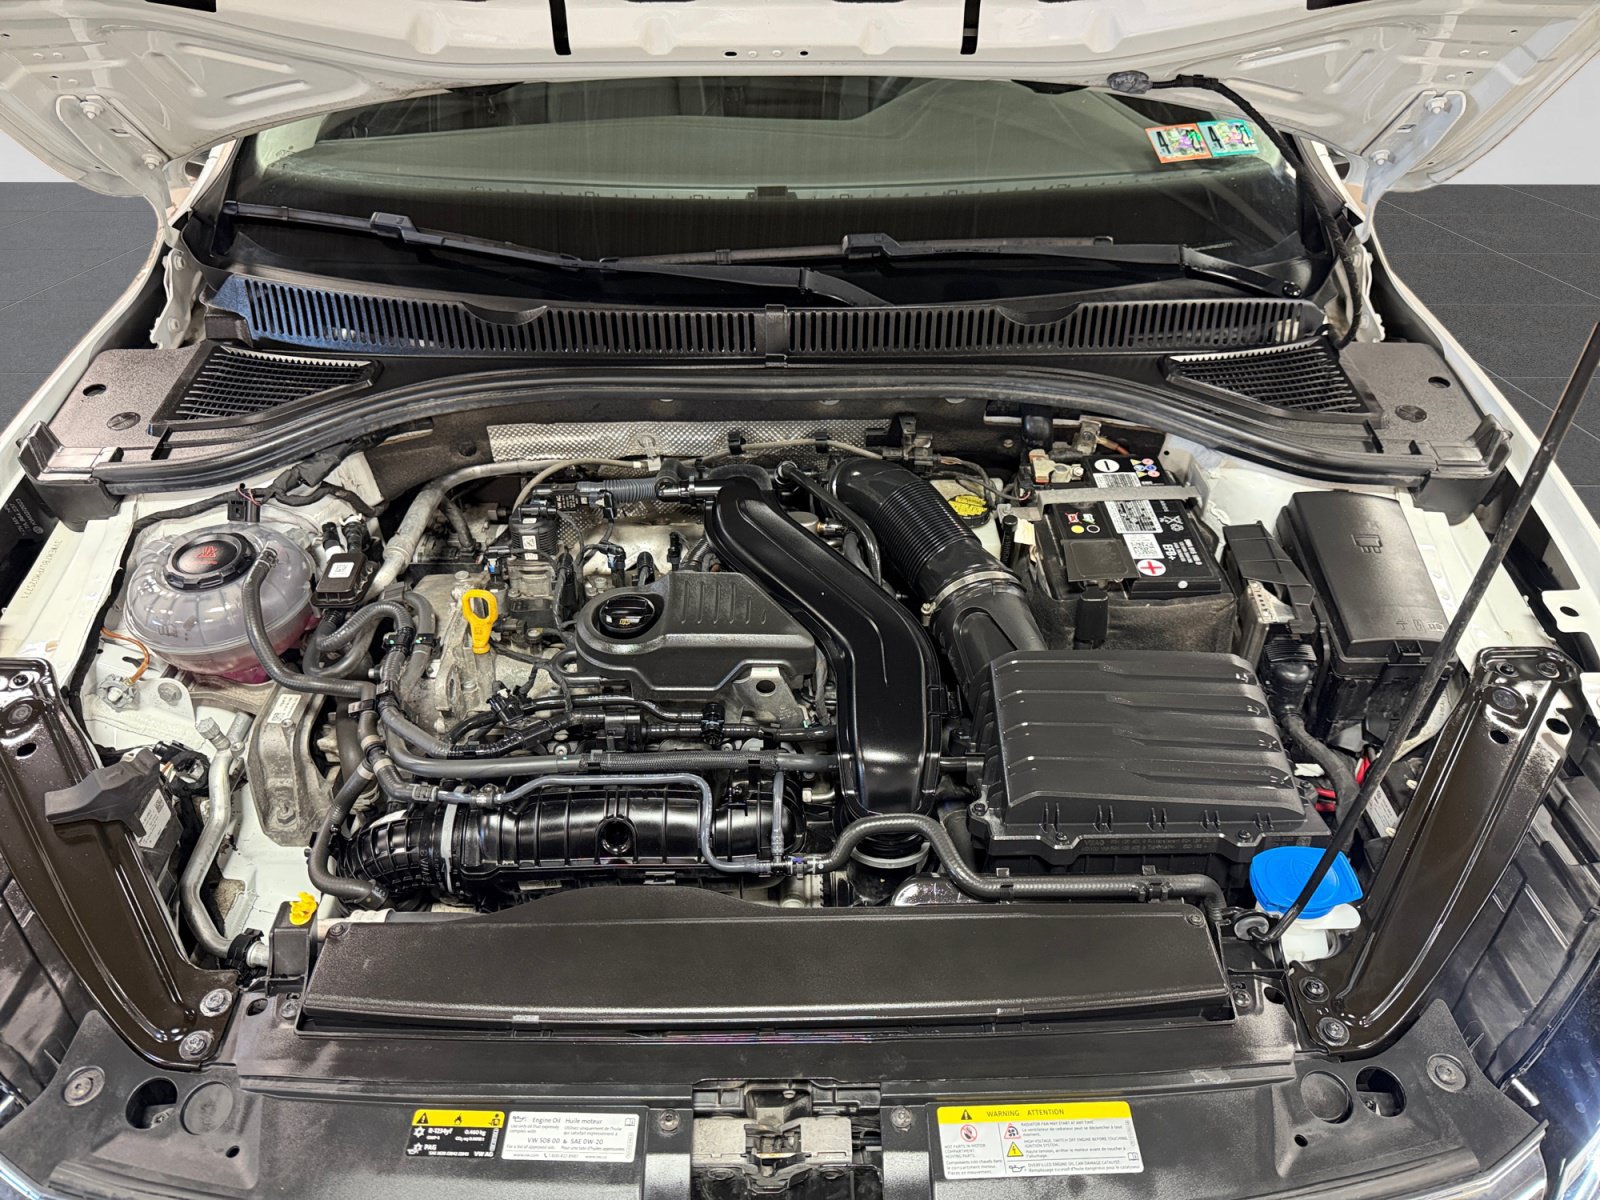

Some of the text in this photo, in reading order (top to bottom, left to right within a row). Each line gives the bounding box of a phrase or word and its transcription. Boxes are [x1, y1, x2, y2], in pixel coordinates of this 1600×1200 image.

[1156, 131, 1171, 154] 4
[1207, 126, 1223, 149] 4
[1027, 1108, 1065, 1116] ATTENTION
[532, 1117, 552, 1125] Engine
